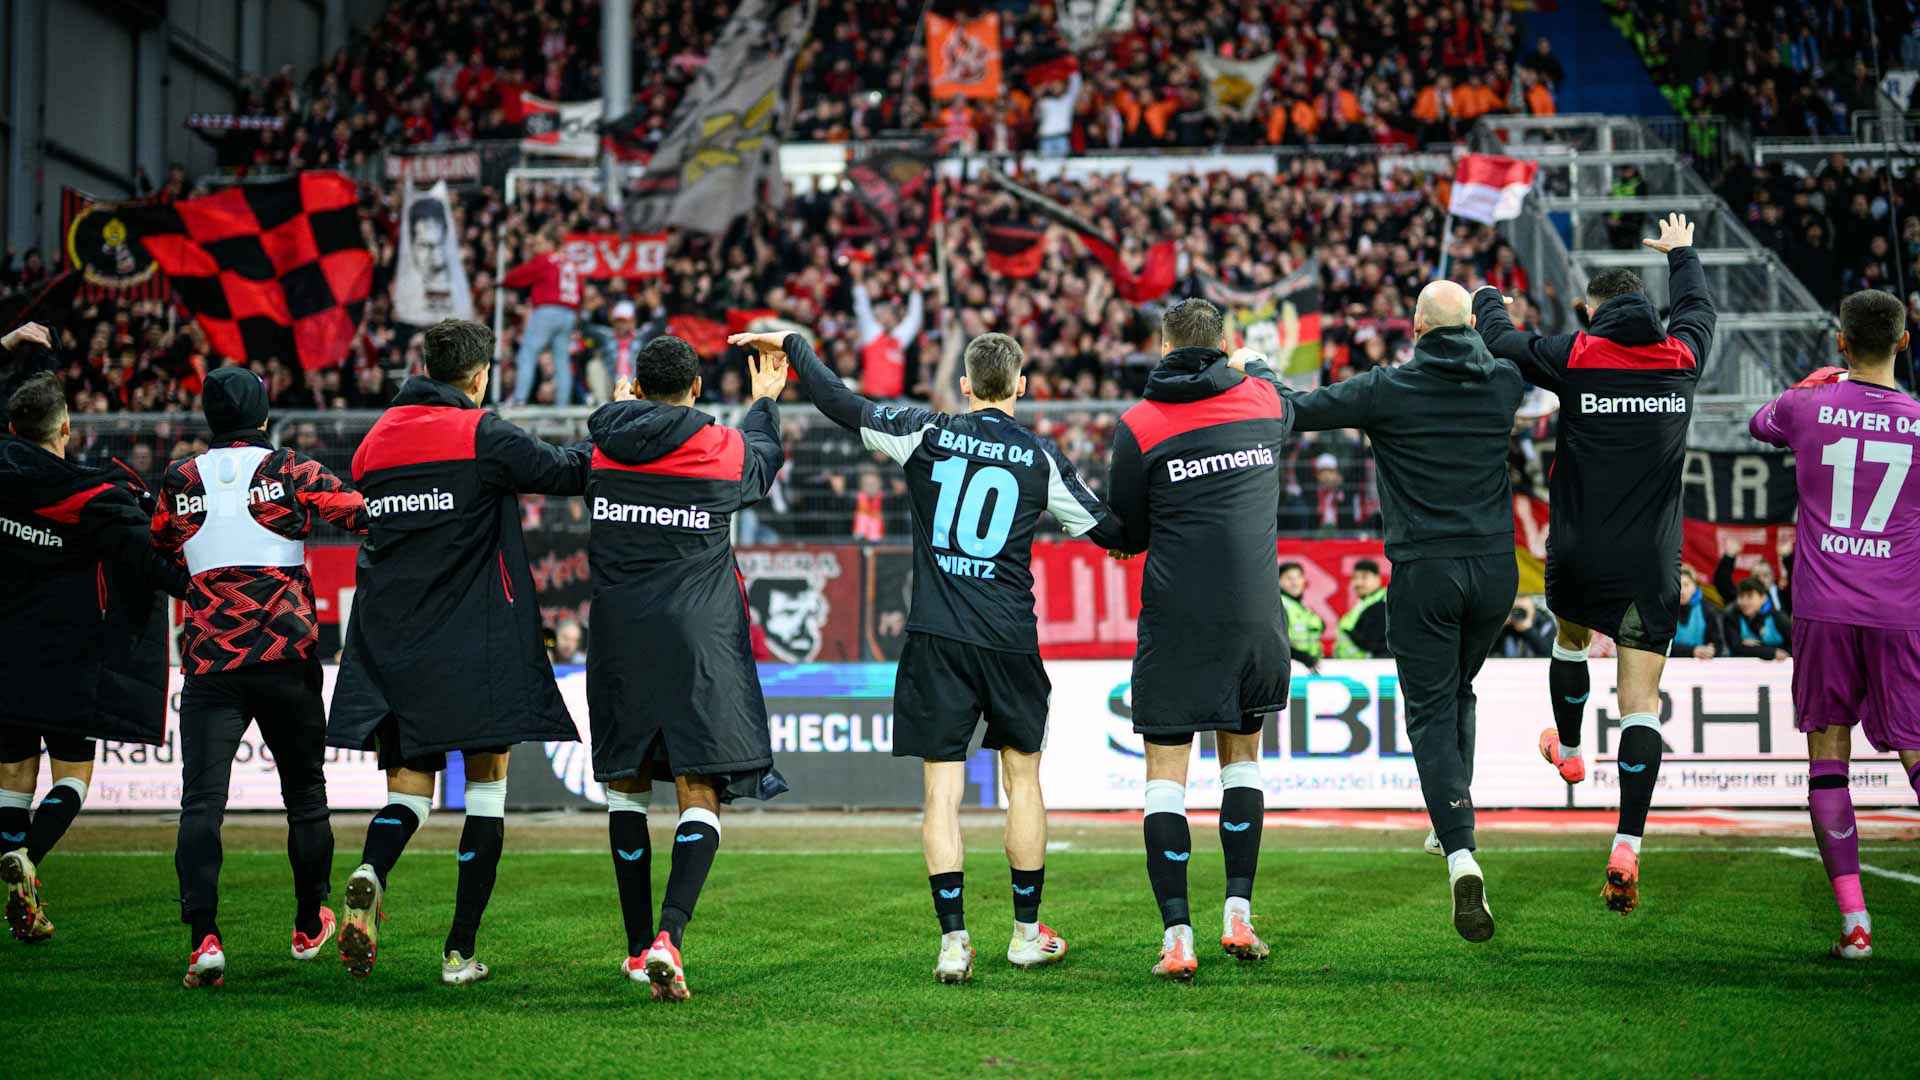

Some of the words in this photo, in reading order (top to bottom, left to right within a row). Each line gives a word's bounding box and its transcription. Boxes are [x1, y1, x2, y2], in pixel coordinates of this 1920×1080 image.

[1580, 393, 1686, 414] Barmenia
[1817, 405, 1890, 432] BAYER
[938, 429, 1006, 461] BAYER
[1008, 446, 1034, 467] 04
[1167, 443, 1274, 483] Barmenia
[1821, 436, 1913, 533] 17
[593, 497, 711, 529] Barmenia
[931, 455, 1020, 560] 10
[1820, 533, 1892, 559] KOVAR
[936, 553, 996, 580] WIRTZ
